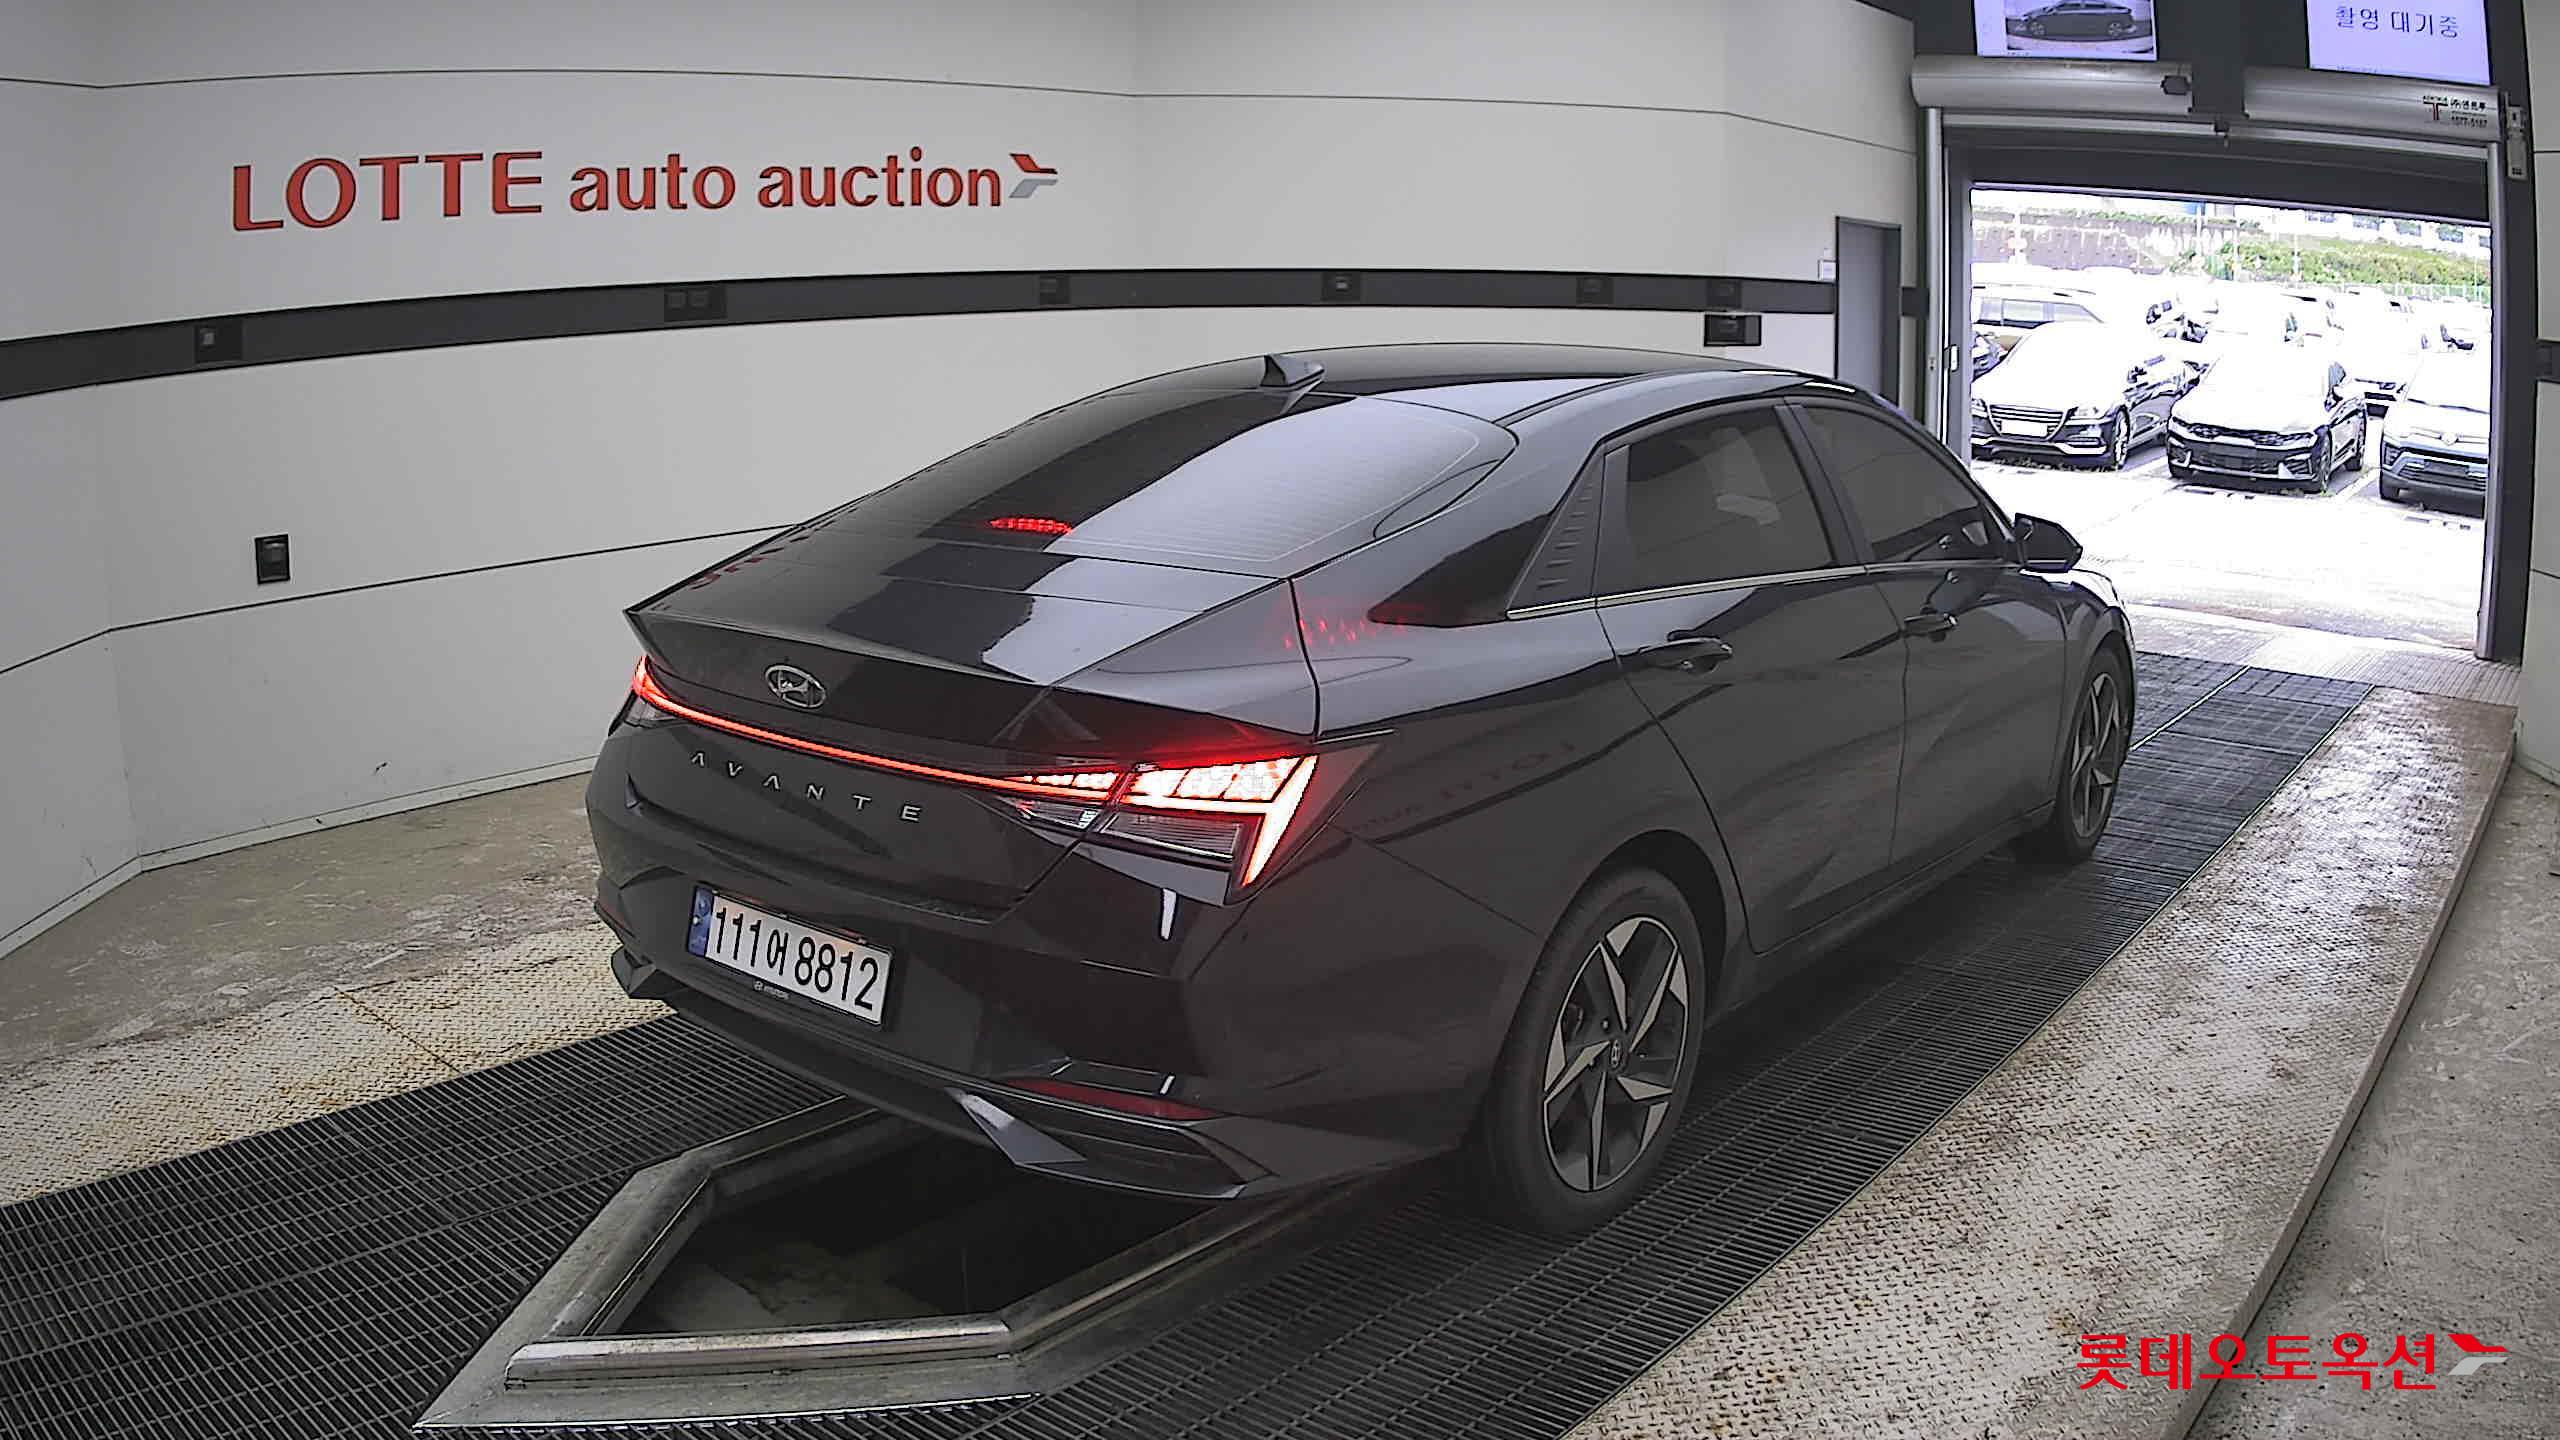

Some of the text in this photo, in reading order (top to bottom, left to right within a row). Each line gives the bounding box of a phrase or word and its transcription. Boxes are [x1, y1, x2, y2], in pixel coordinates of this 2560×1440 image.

[233, 146, 1002, 231] LOTTE auto auction
[691, 752, 922, 822] AVANTE
